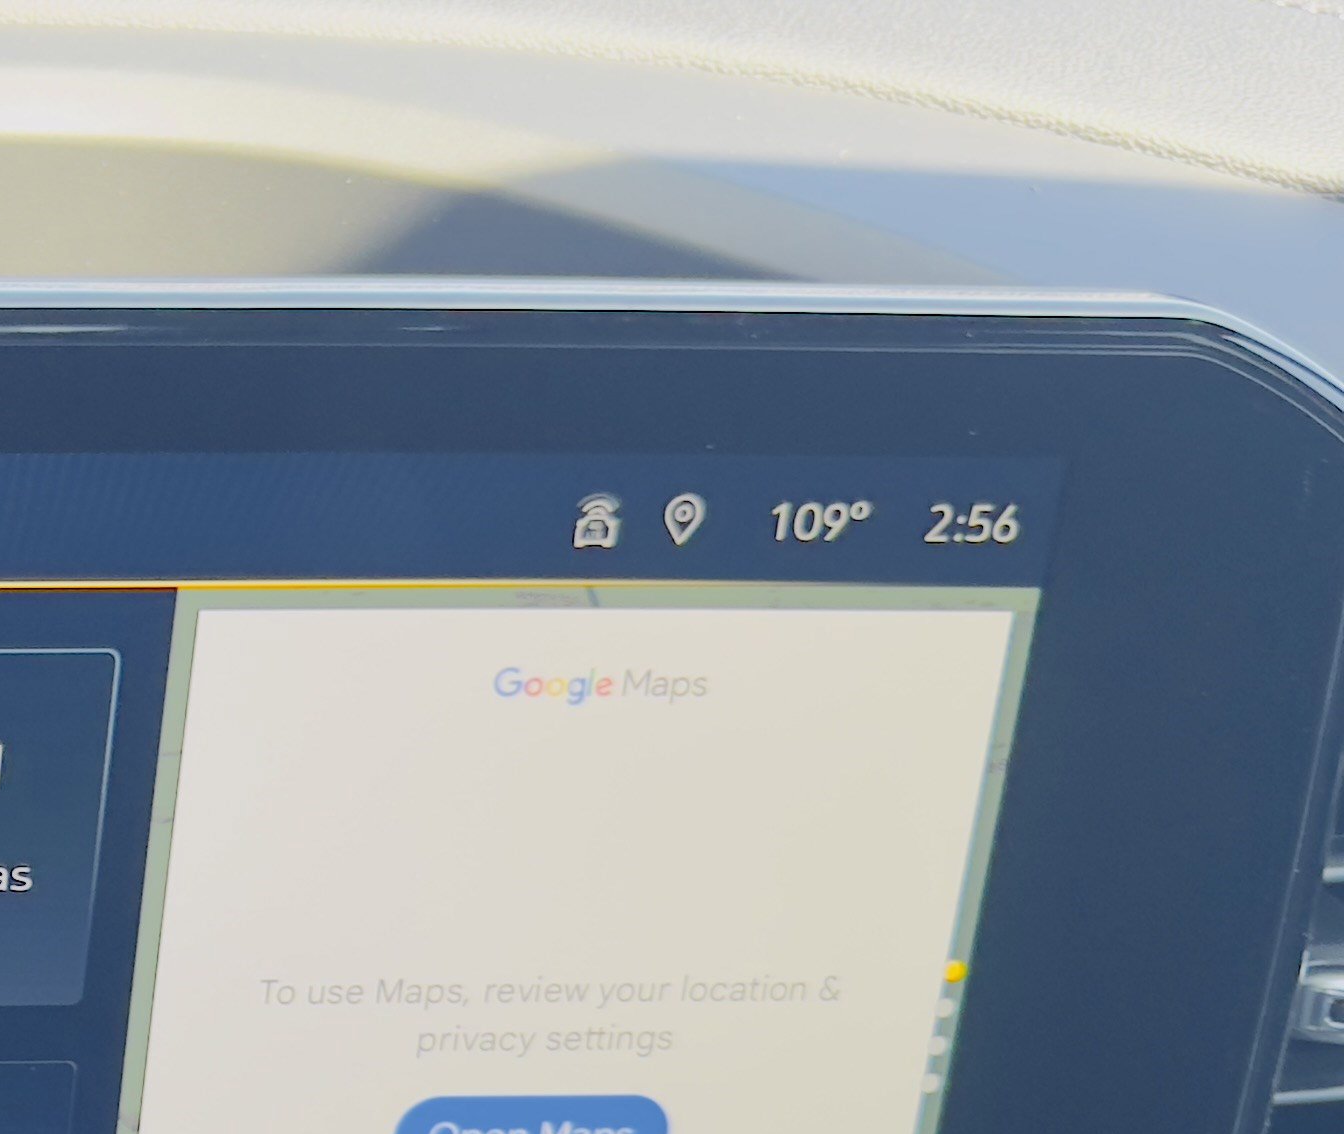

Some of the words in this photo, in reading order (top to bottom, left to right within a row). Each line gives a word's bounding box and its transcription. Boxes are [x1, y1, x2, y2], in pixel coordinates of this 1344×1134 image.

[923, 502, 1022, 544] 2:56
[493, 666, 614, 706] Google
[621, 668, 708, 705] Maps
[260, 978, 297, 1006] To
[307, 983, 365, 1005] use
[375, 978, 469, 1011] Maps,
[483, 975, 590, 1004] review
[596, 981, 672, 1010] your
[680, 974, 808, 1003] location
[818, 975, 842, 1003] &
[415, 1024, 537, 1059] privacy
[545, 1022, 675, 1058] settings
